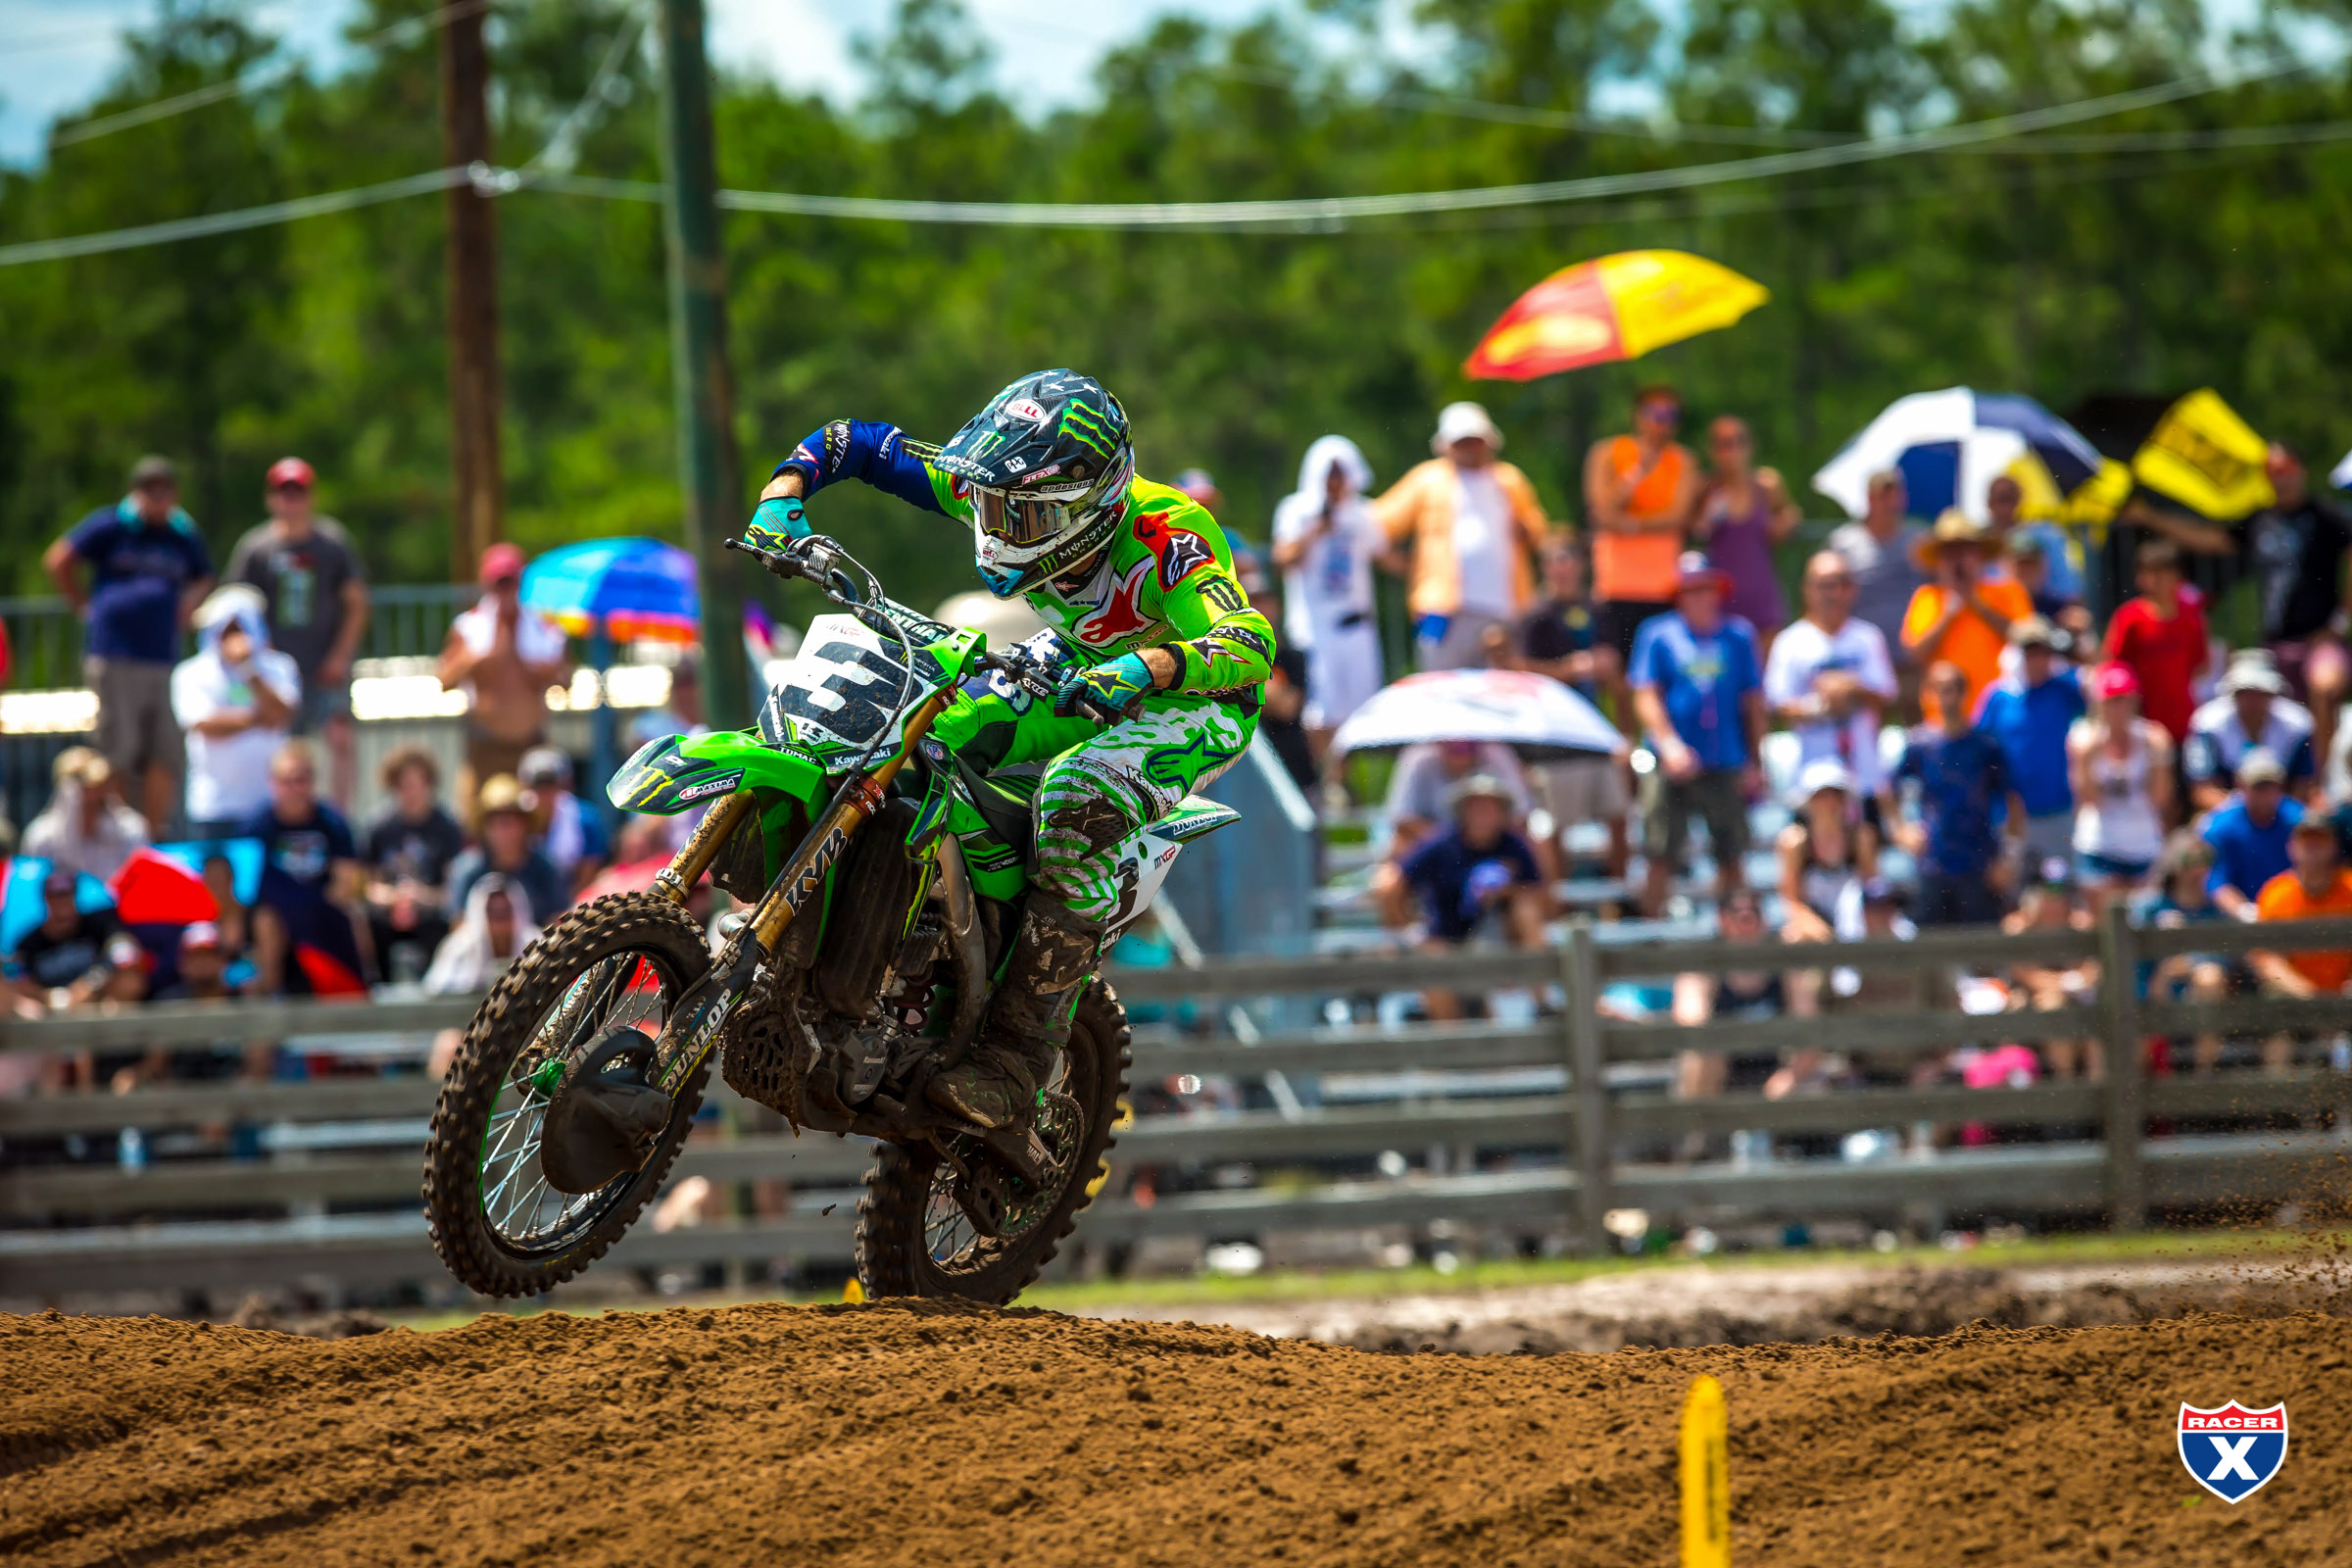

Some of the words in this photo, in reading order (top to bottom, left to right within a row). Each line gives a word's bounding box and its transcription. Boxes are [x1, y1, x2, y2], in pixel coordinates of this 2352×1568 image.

[935, 454, 996, 482] MONSTER
[1041, 478, 1095, 492] apdesigns
[1059, 510, 1117, 559] MONSTER
[780, 641, 923, 743] 3
[779, 746, 817, 764] TOMAC
[695, 778, 735, 794] MAXIMA
[661, 988, 732, 1093] DUNLOP
